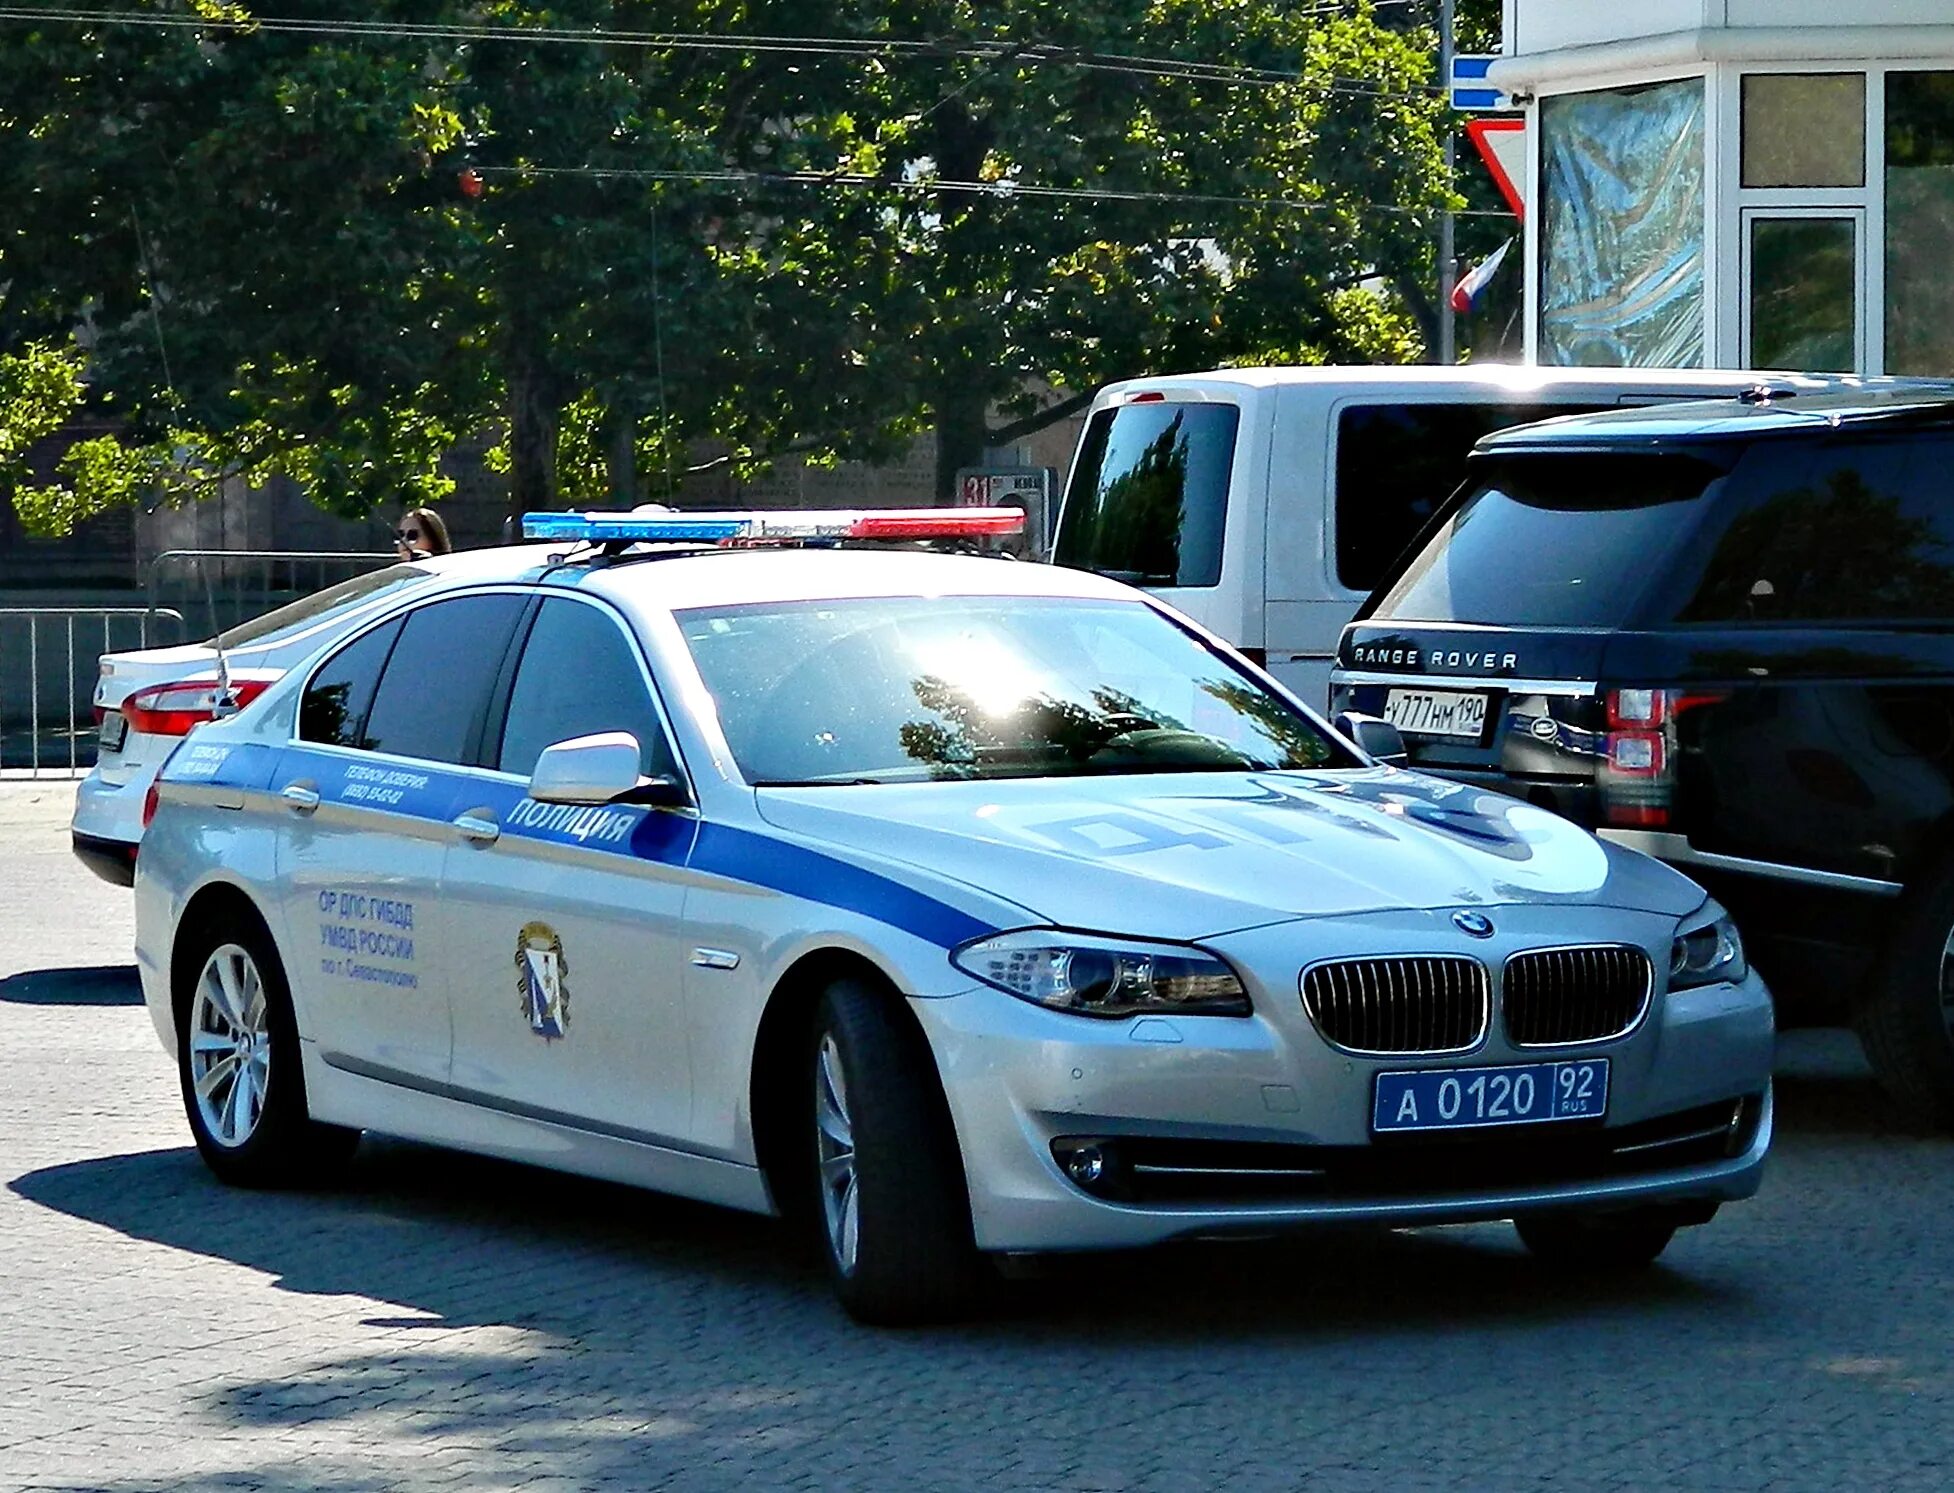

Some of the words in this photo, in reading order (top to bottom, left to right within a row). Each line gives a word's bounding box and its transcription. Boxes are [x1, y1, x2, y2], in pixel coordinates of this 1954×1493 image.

[1354, 648, 1418, 664] RANGE
[1431, 651, 1517, 668] ROVER
[1457, 697, 1484, 721] 190
[506, 798, 635, 842] ПОЛИЦИЯ
[319, 890, 337, 912] ОР
[339, 893, 366, 919] ДПС
[370, 898, 414, 931] ГИБДД
[320, 924, 358, 954] УМВД
[359, 930, 414, 960] РОССИИ
[1437, 1073, 1535, 1120] 0120
[1560, 1066, 1594, 1099] 92
[1561, 1100, 1587, 1112] RUS
